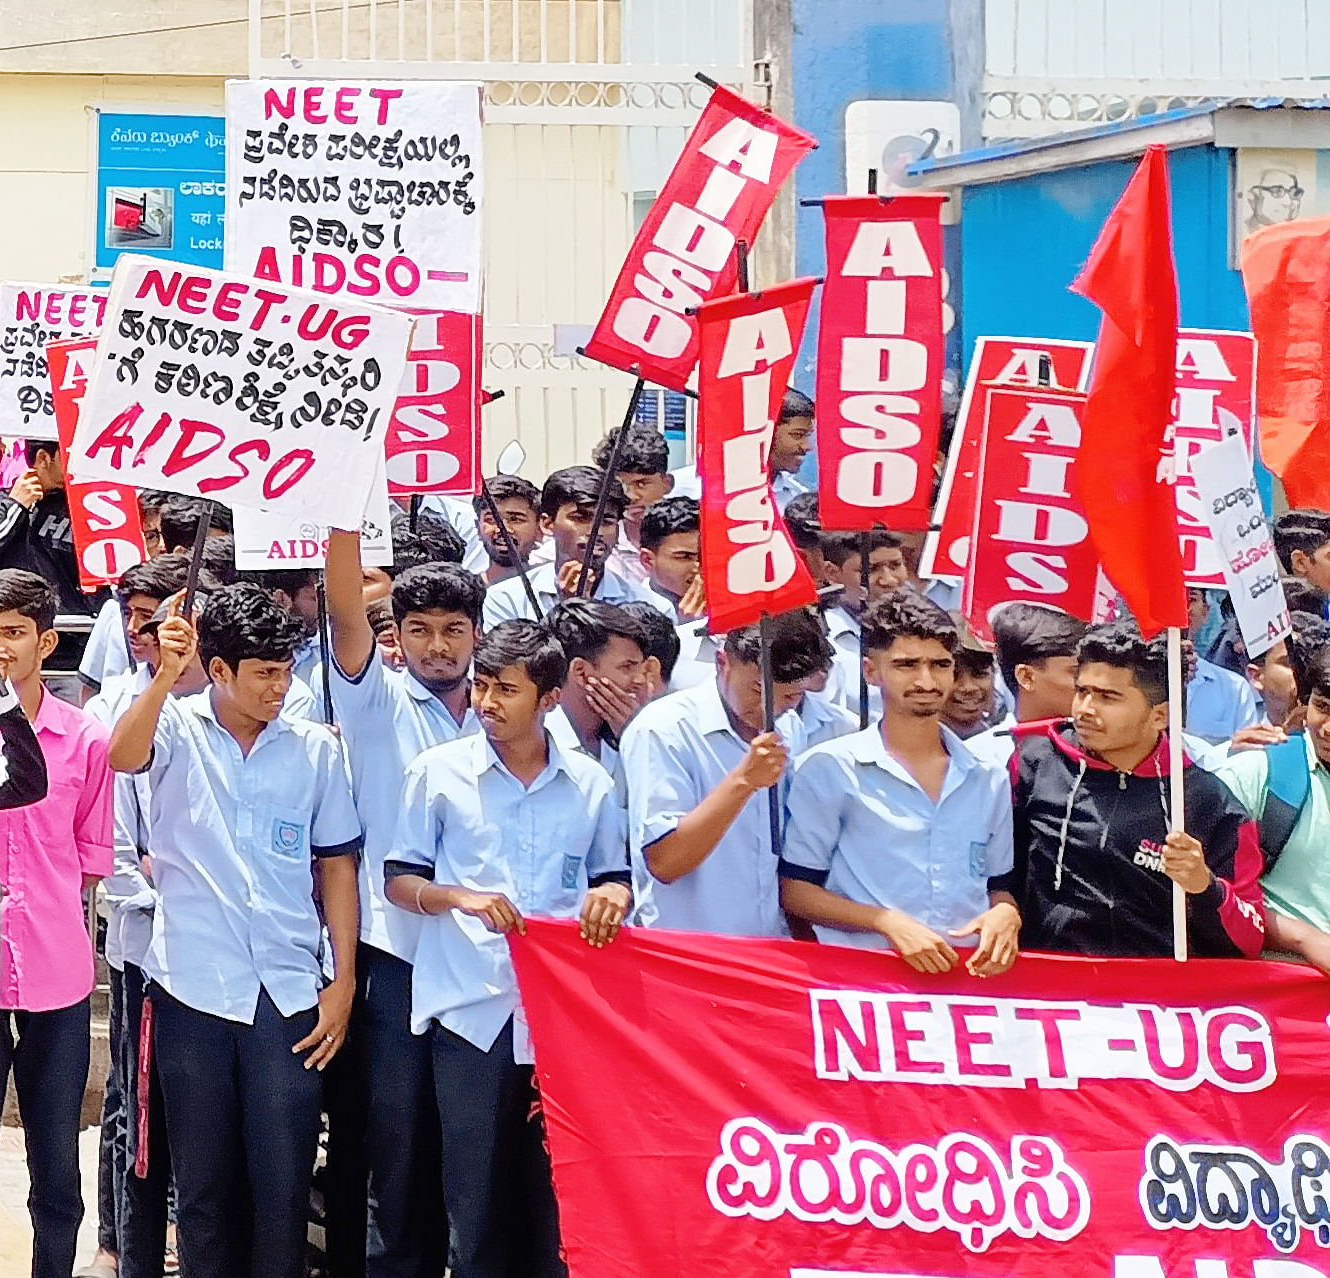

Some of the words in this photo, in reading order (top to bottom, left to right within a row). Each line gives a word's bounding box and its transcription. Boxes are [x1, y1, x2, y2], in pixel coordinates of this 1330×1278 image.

[264, 87, 403, 125] NEET
[253, 246, 420, 297] AIDSO
[612, 116, 779, 359] AIDSO
[15, 291, 109, 327] NEET
[386, 313, 460, 487] IDSO
[836, 220, 935, 507] AIDSO
[85, 401, 316, 500] AIDSO
[267, 539, 330, 559] AIDS
[987, 402, 1089, 622] AIDS
[820, 998, 1271, 1087] NEET-UG
[714, 1122, 1088, 1250] ವಿರೋಧಿಸಿ
